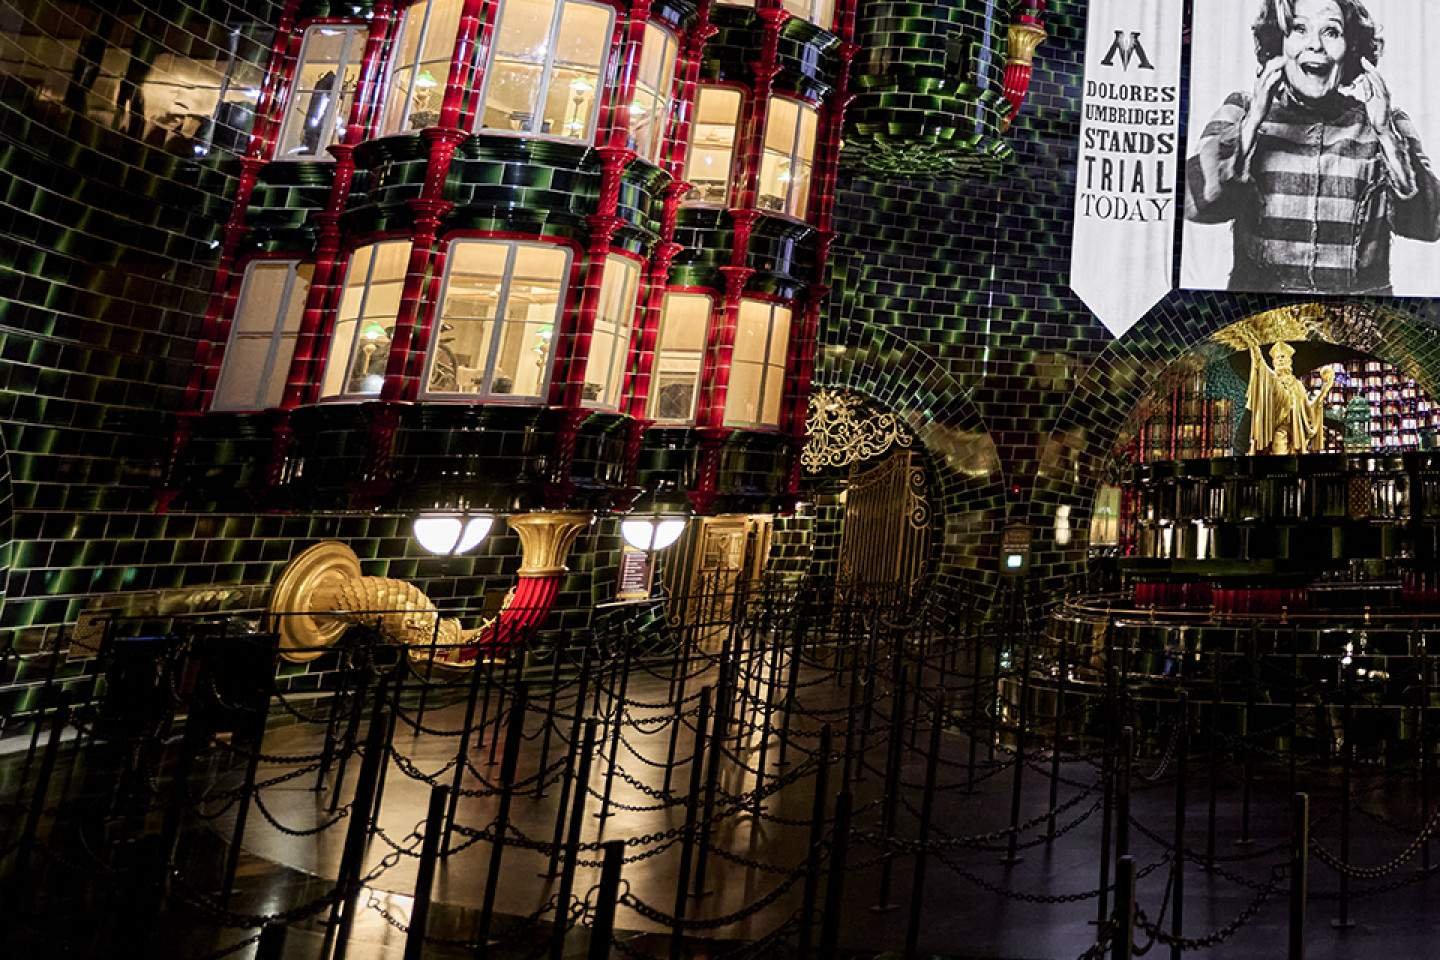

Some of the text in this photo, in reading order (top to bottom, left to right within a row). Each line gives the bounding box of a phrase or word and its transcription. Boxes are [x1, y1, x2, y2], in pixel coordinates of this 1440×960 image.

[1086, 80, 1175, 102] DOLORES
[1085, 104, 1174, 126] UMBRIDGE
[1085, 127, 1174, 154] STANDS
[1084, 155, 1172, 193] TRIAL
[1080, 192, 1173, 222] TODAY
